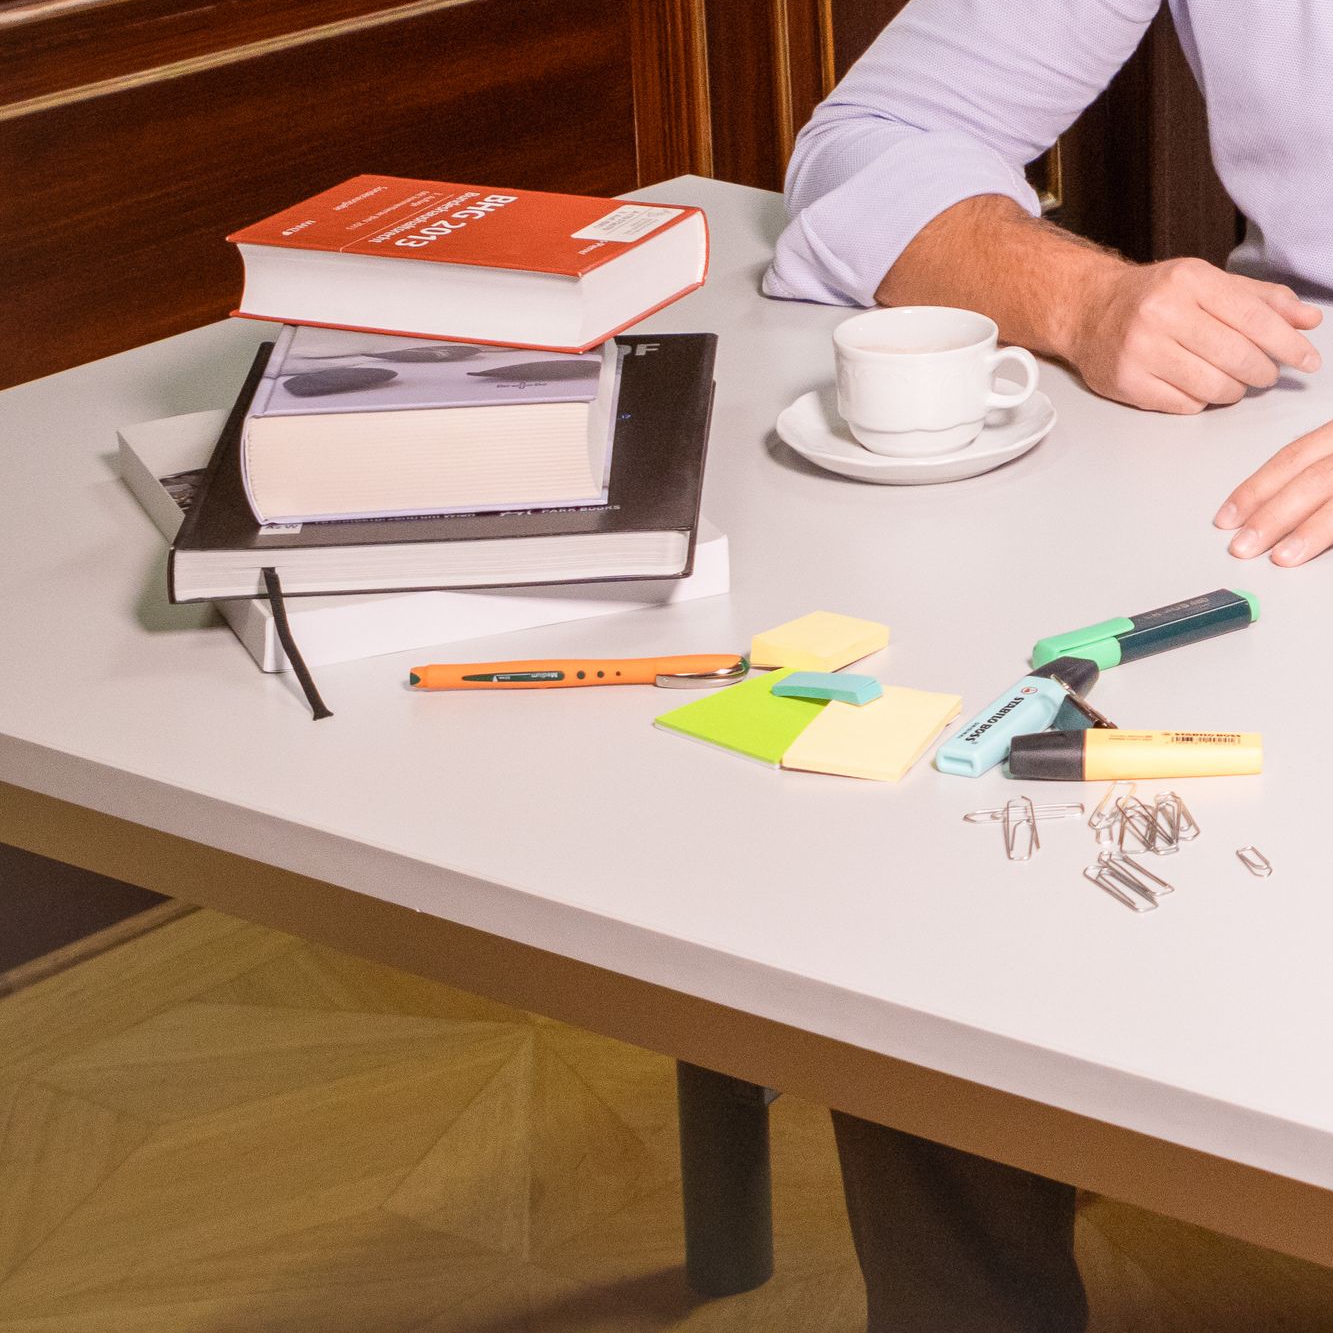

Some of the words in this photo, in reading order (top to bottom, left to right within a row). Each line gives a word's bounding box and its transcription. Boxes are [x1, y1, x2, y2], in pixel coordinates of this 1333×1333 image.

[451, 194, 519, 221] BHG
[394, 219, 466, 248] 2013
[580, 504, 622, 512] BOOKS
[987, 697, 1024, 724] STABILO
[965, 724, 992, 742] BOSS
